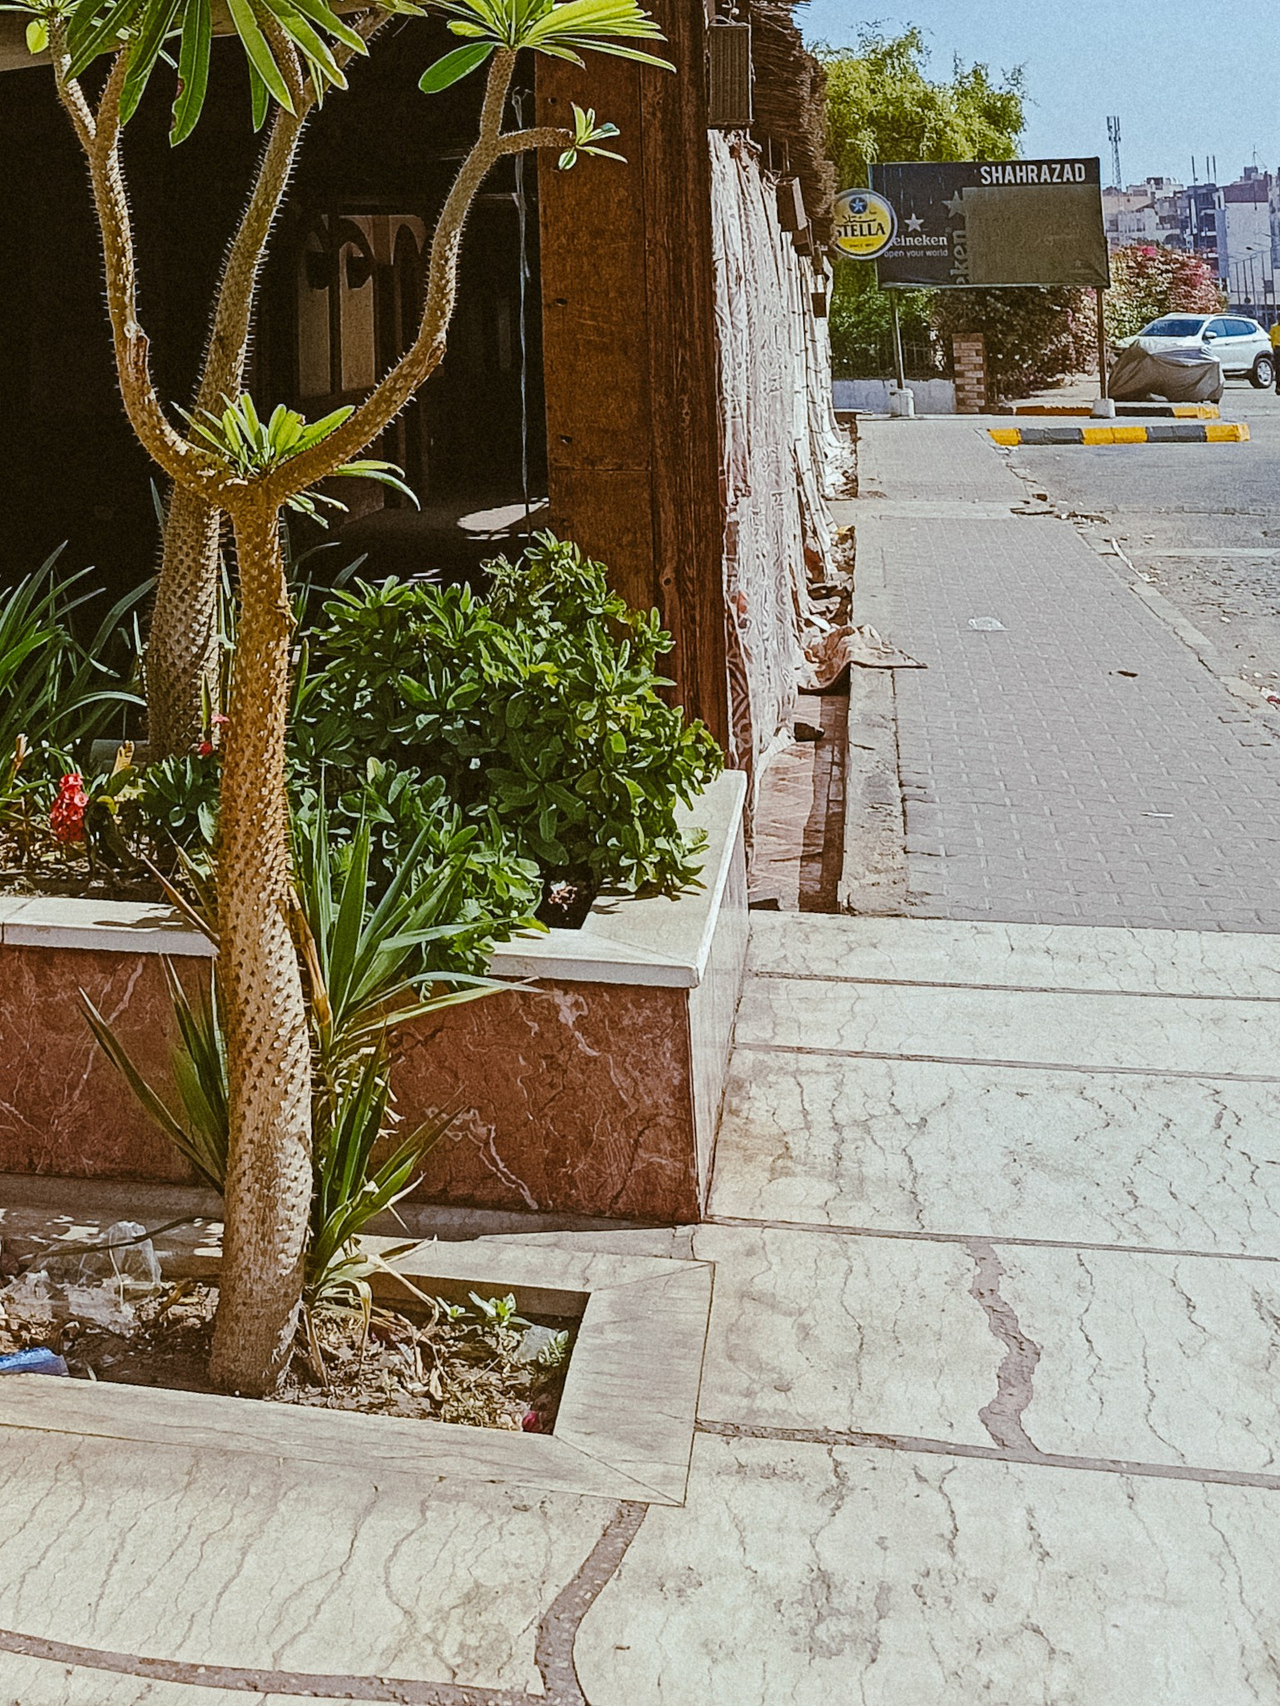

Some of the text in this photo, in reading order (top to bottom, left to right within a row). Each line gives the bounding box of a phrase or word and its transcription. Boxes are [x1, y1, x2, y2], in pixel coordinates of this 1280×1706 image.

[980, 163, 1086, 185] SHAHRAZAD
[891, 234, 948, 246] eineken
[883, 248, 949, 259] open your world
